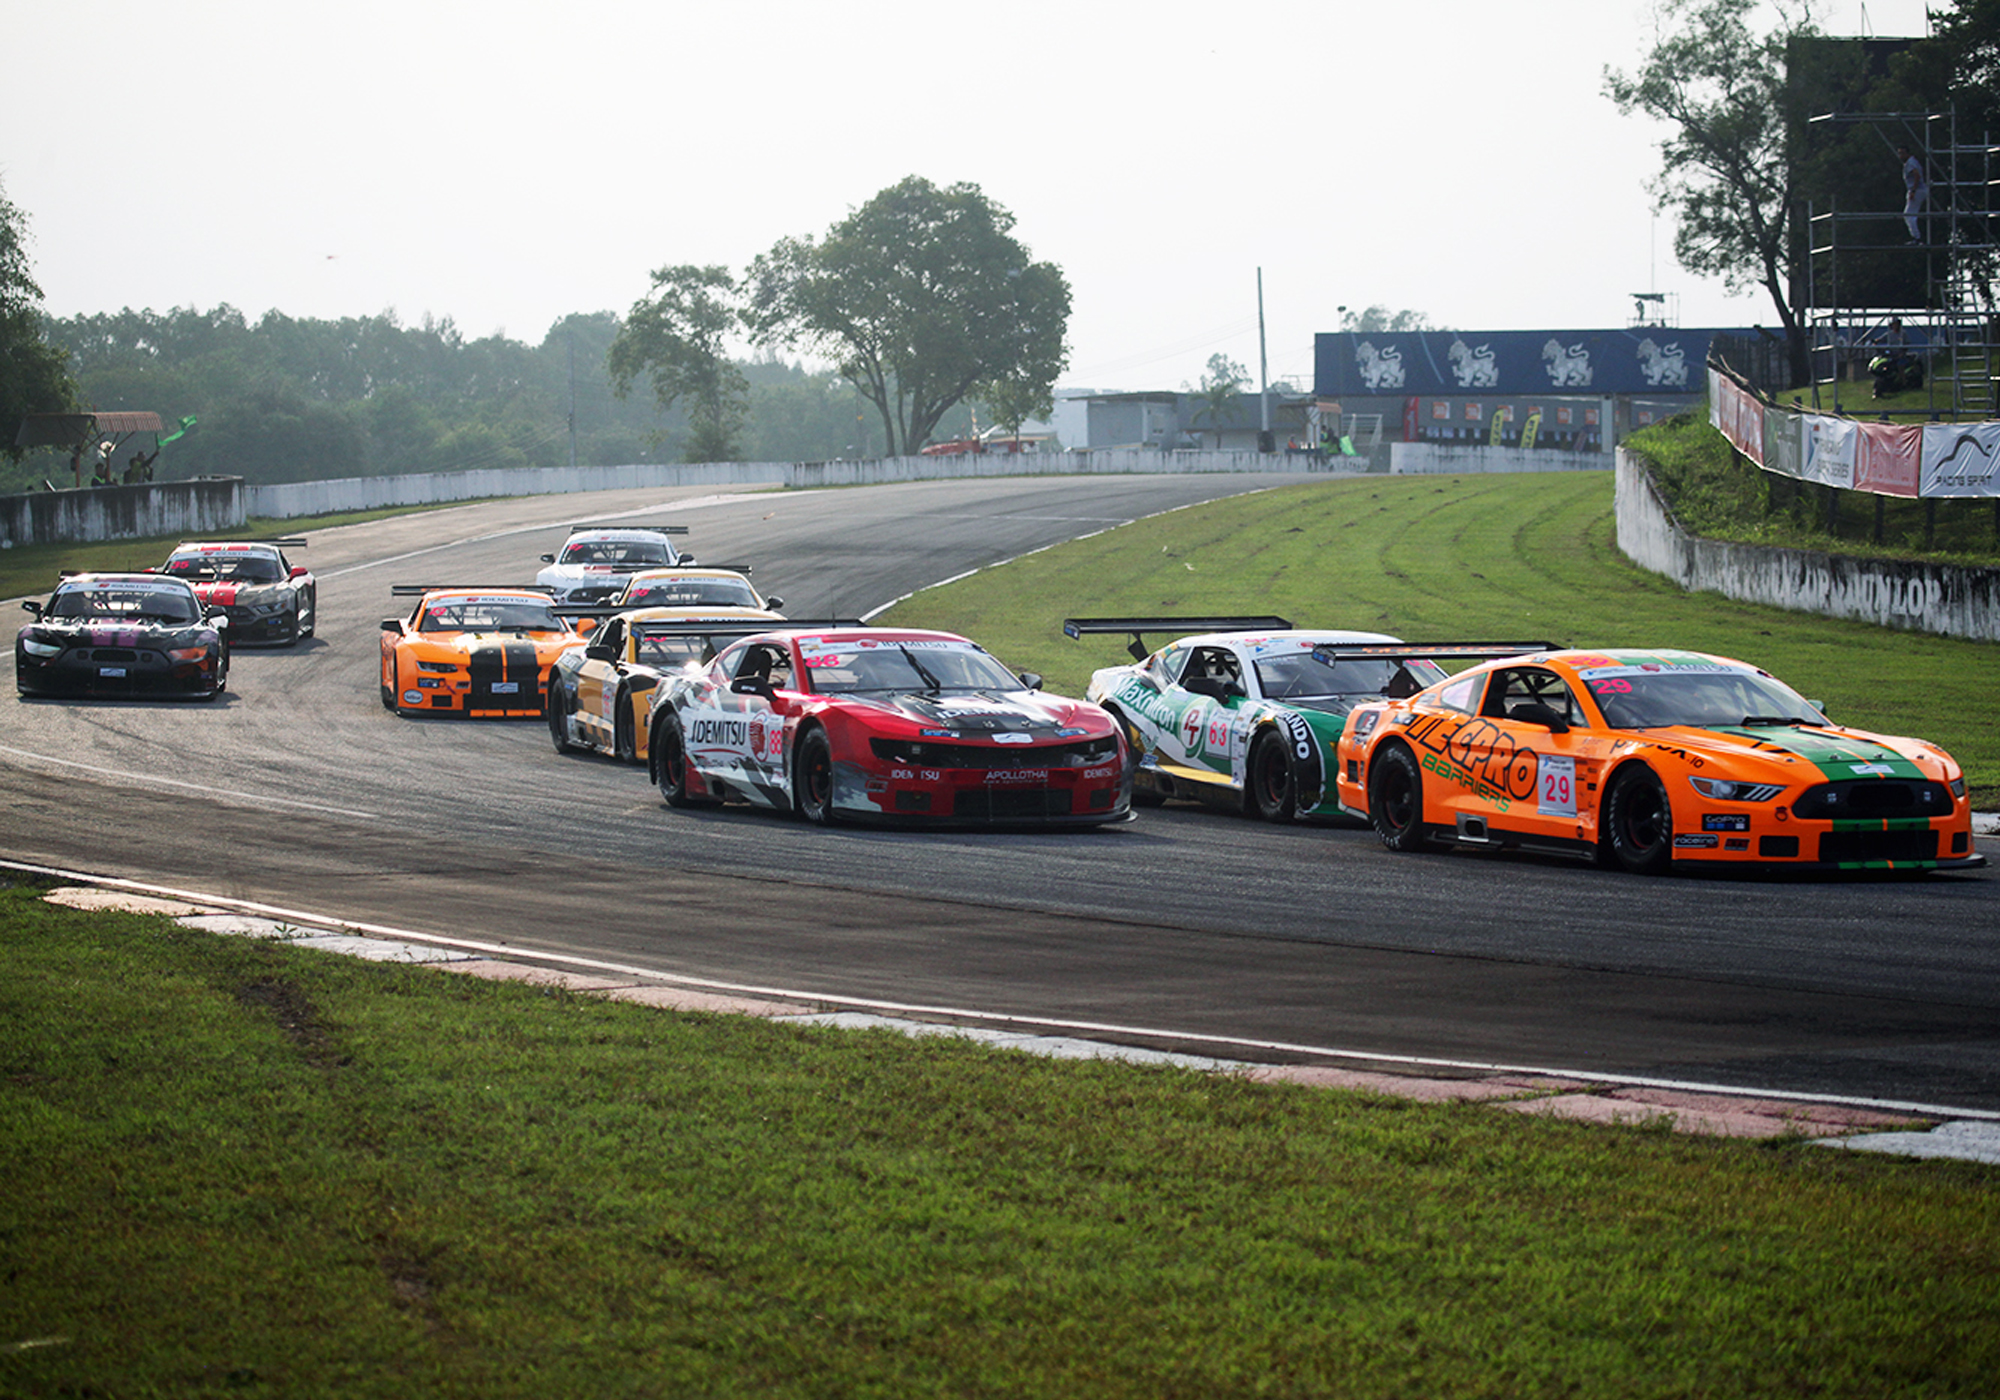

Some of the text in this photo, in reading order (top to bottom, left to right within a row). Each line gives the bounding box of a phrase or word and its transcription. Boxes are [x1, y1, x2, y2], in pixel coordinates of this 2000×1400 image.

[170, 560, 190, 570] 35
[805, 653, 840, 668] 88
[1591, 678, 1633, 694] 29
[691, 720, 747, 746] IDEMITSU
[769, 729, 783, 755] 88
[1209, 721, 1228, 747] 63
[1404, 716, 1539, 801] TECPRO
[985, 769, 1049, 780] APOLLOTHAI
[1545, 774, 1570, 804] 29
[1705, 815, 1746, 823] GoPro
